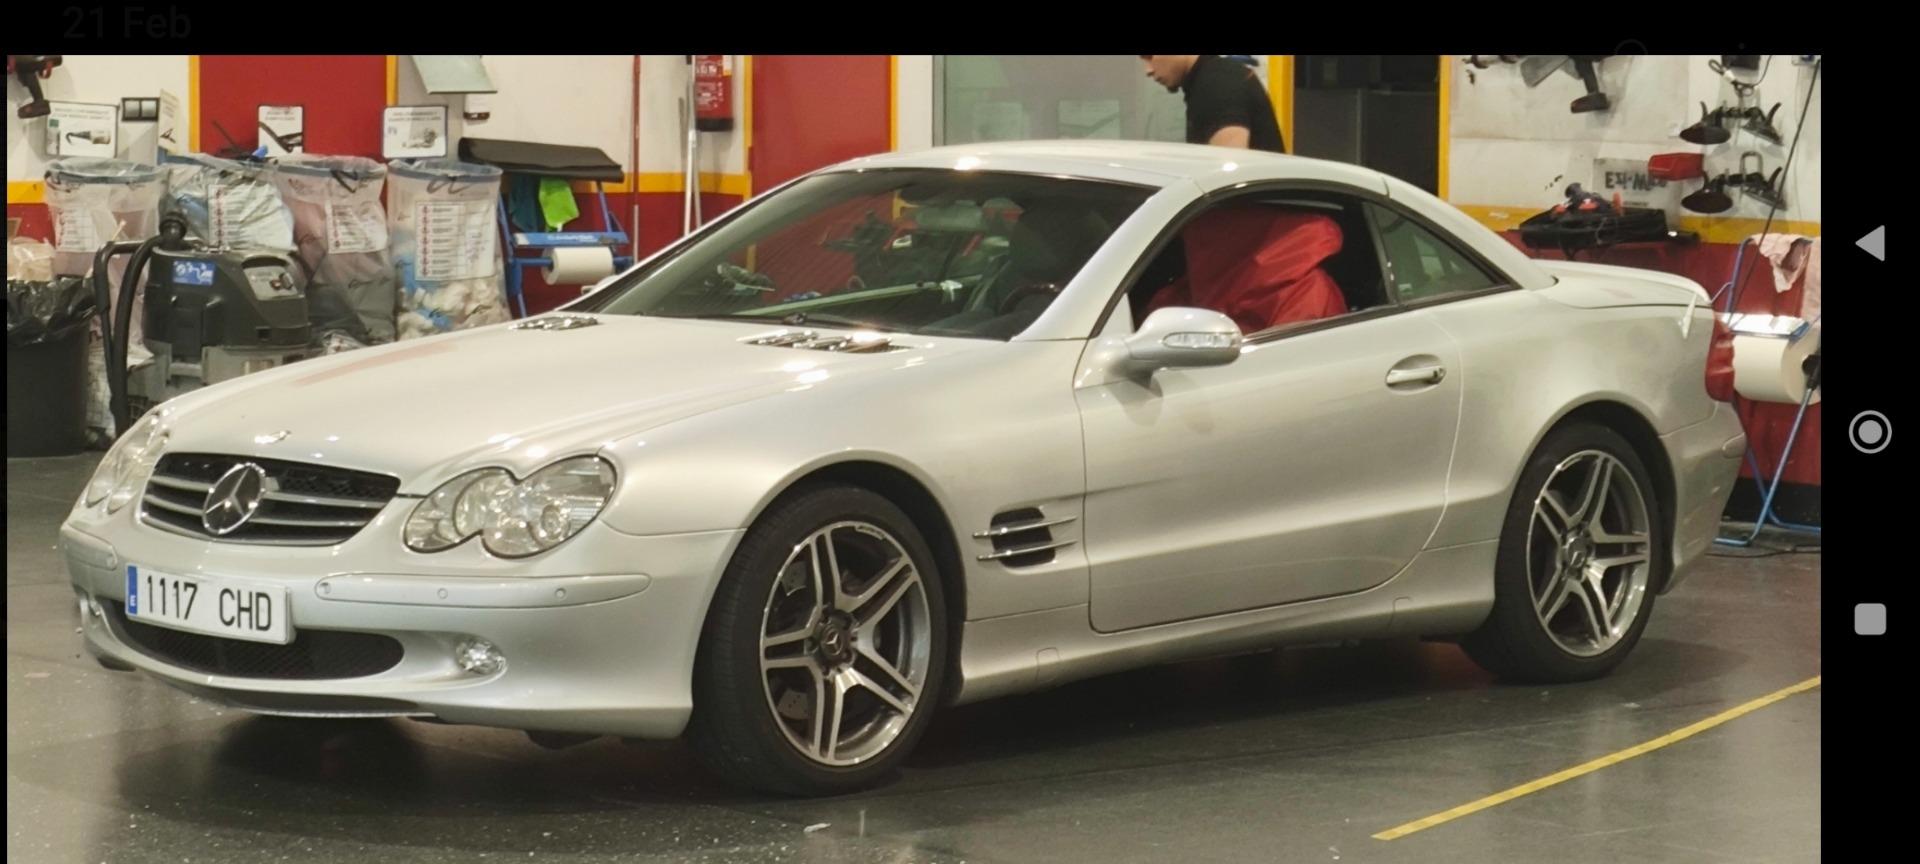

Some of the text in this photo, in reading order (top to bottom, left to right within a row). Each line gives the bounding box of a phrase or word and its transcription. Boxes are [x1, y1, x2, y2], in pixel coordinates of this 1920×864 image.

[130, 575, 272, 632] E 1117 CHD
